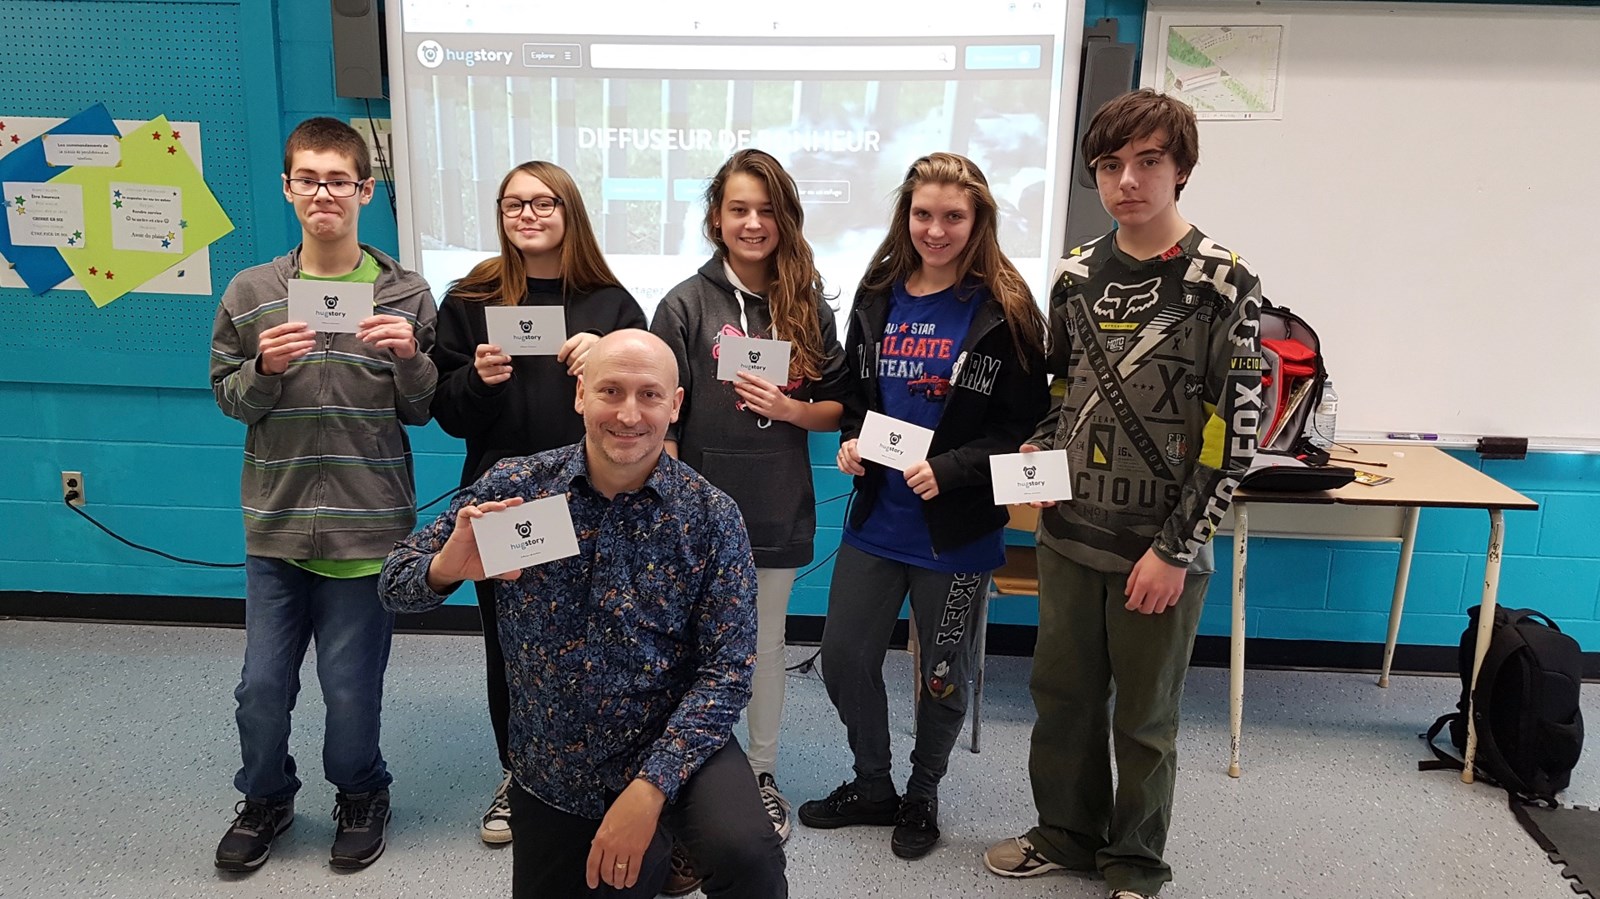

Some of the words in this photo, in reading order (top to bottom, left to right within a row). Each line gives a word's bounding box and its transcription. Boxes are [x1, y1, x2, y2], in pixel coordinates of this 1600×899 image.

[446, 48, 513, 67] hugstory
[578, 127, 713, 150] DIFFUSEUR
[719, 128, 751, 150] DE
[758, 129, 880, 152] NHEUR
[315, 310, 346, 318] hugstory
[910, 322, 936, 335] STAR
[513, 334, 541, 342] hugstory
[882, 335, 953, 359] ILGATE
[740, 363, 767, 372] hugstory
[879, 359, 924, 379] TEAM
[1231, 382, 1262, 458] FOX
[879, 443, 904, 456] hugstory
[1017, 480, 1045, 488] hugstory
[510, 537, 545, 550] hugstory
[937, 573, 982, 645] KEY
